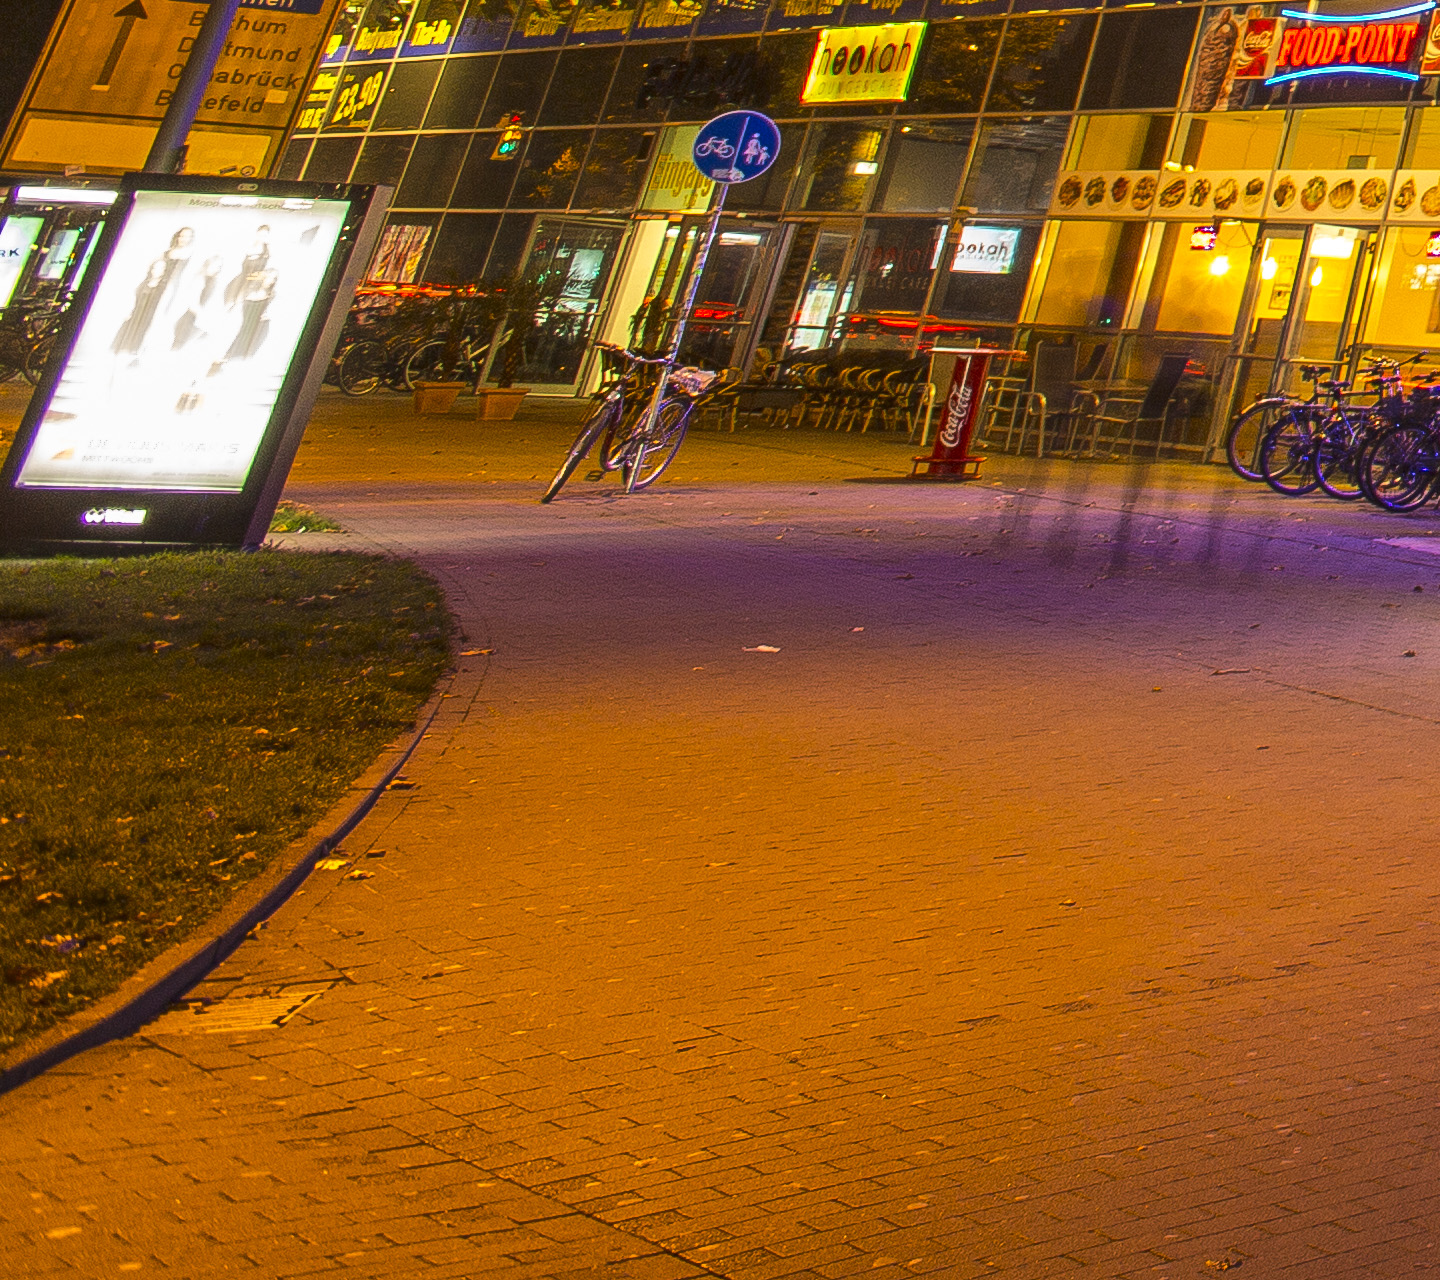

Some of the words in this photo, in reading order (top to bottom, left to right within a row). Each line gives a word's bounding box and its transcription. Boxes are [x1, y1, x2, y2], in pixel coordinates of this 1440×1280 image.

[188, 10, 288, 36] Bhum
[177, 36, 302, 63] Dtmund
[816, 28, 911, 76] hookah
[1276, 22, 1419, 67] FOOD-POINT
[167, 63, 304, 90] Oabrück
